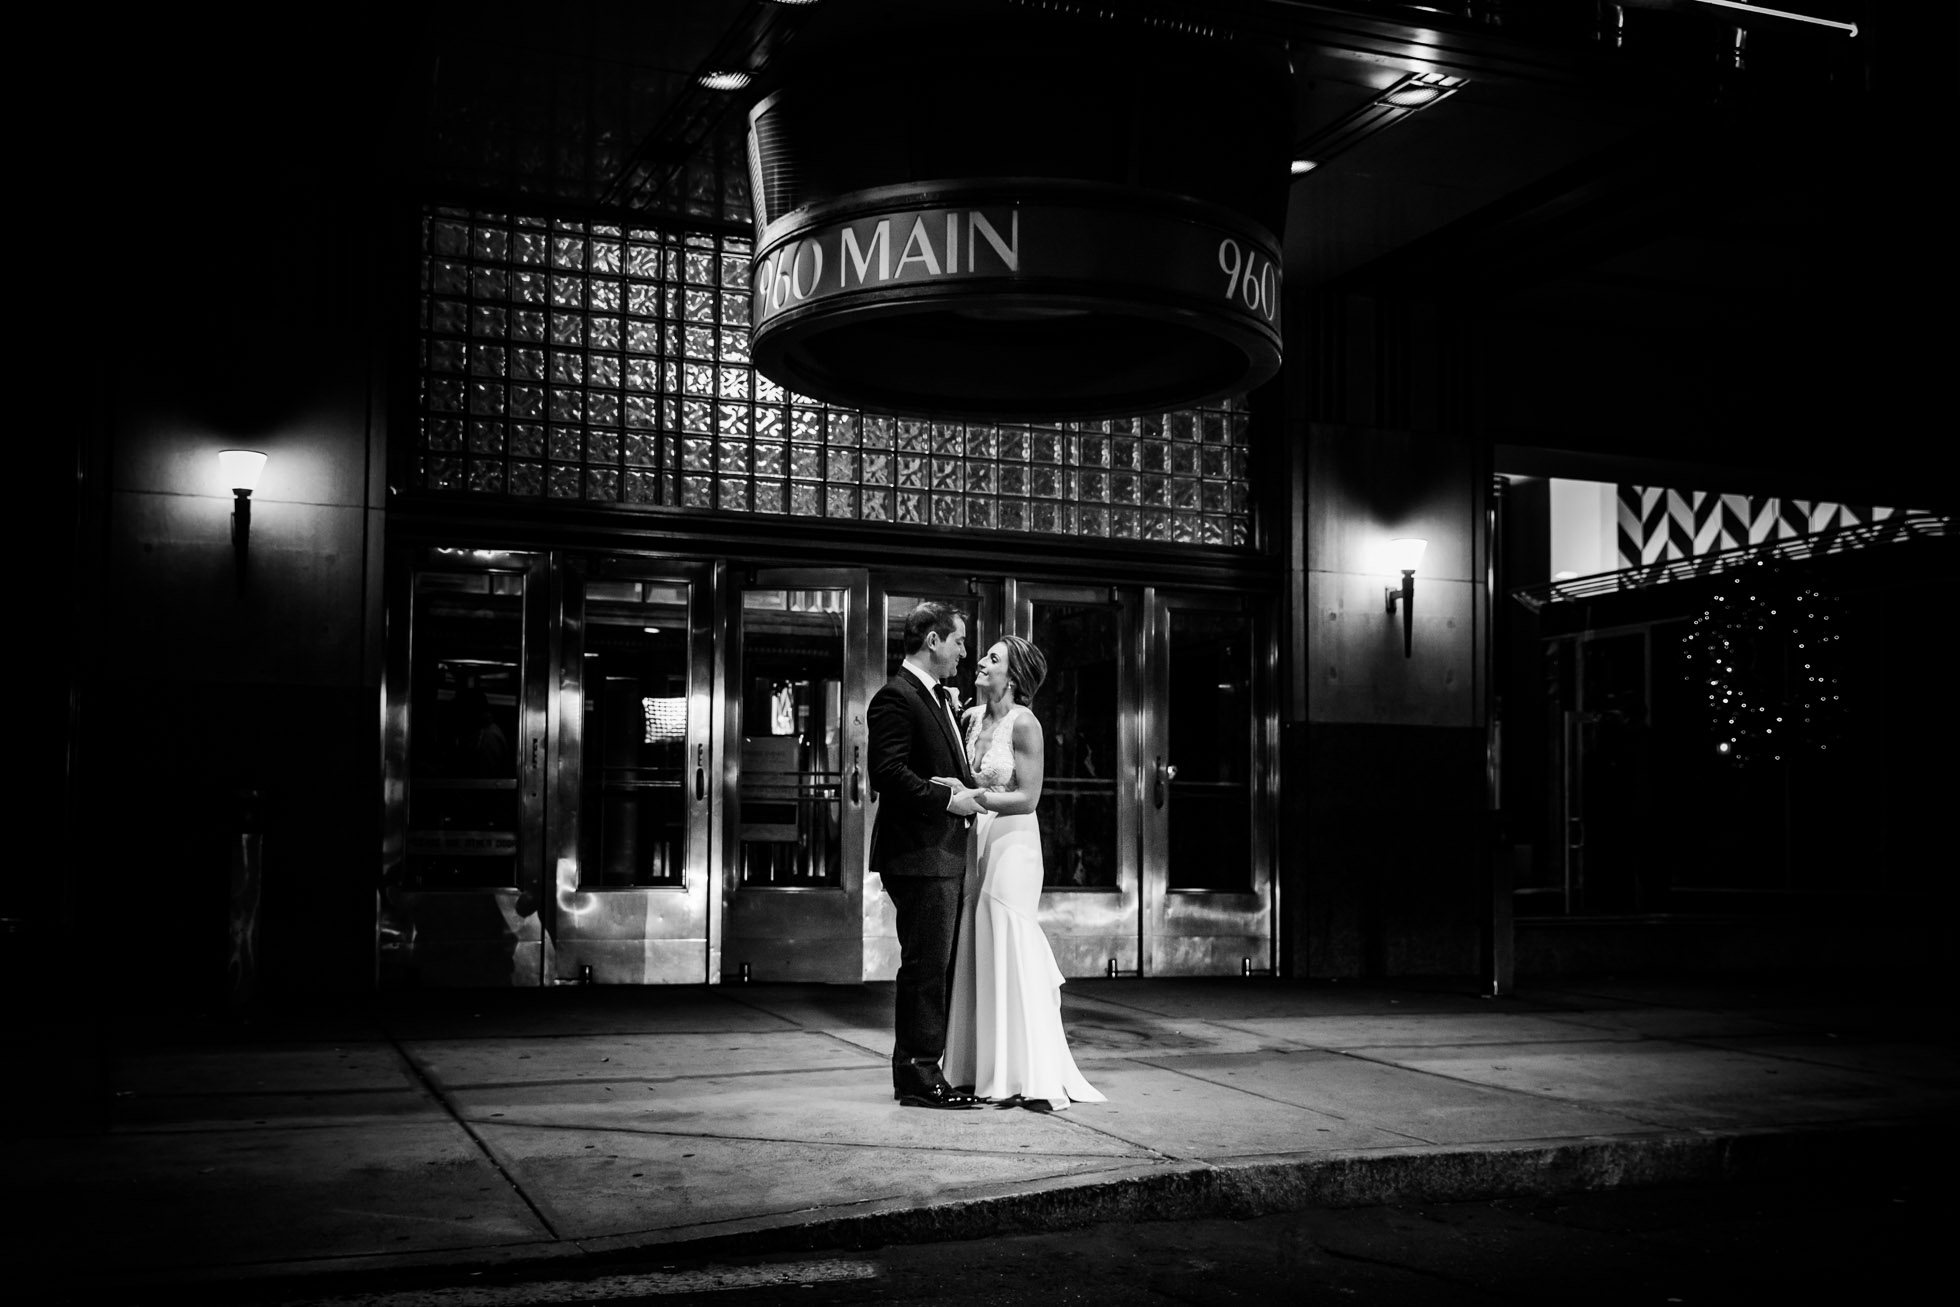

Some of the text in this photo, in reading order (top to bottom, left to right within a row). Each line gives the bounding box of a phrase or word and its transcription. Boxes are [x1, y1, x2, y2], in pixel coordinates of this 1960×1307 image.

[760, 210, 1018, 317] 960 MAIN
[1218, 238, 1275, 320] 960
